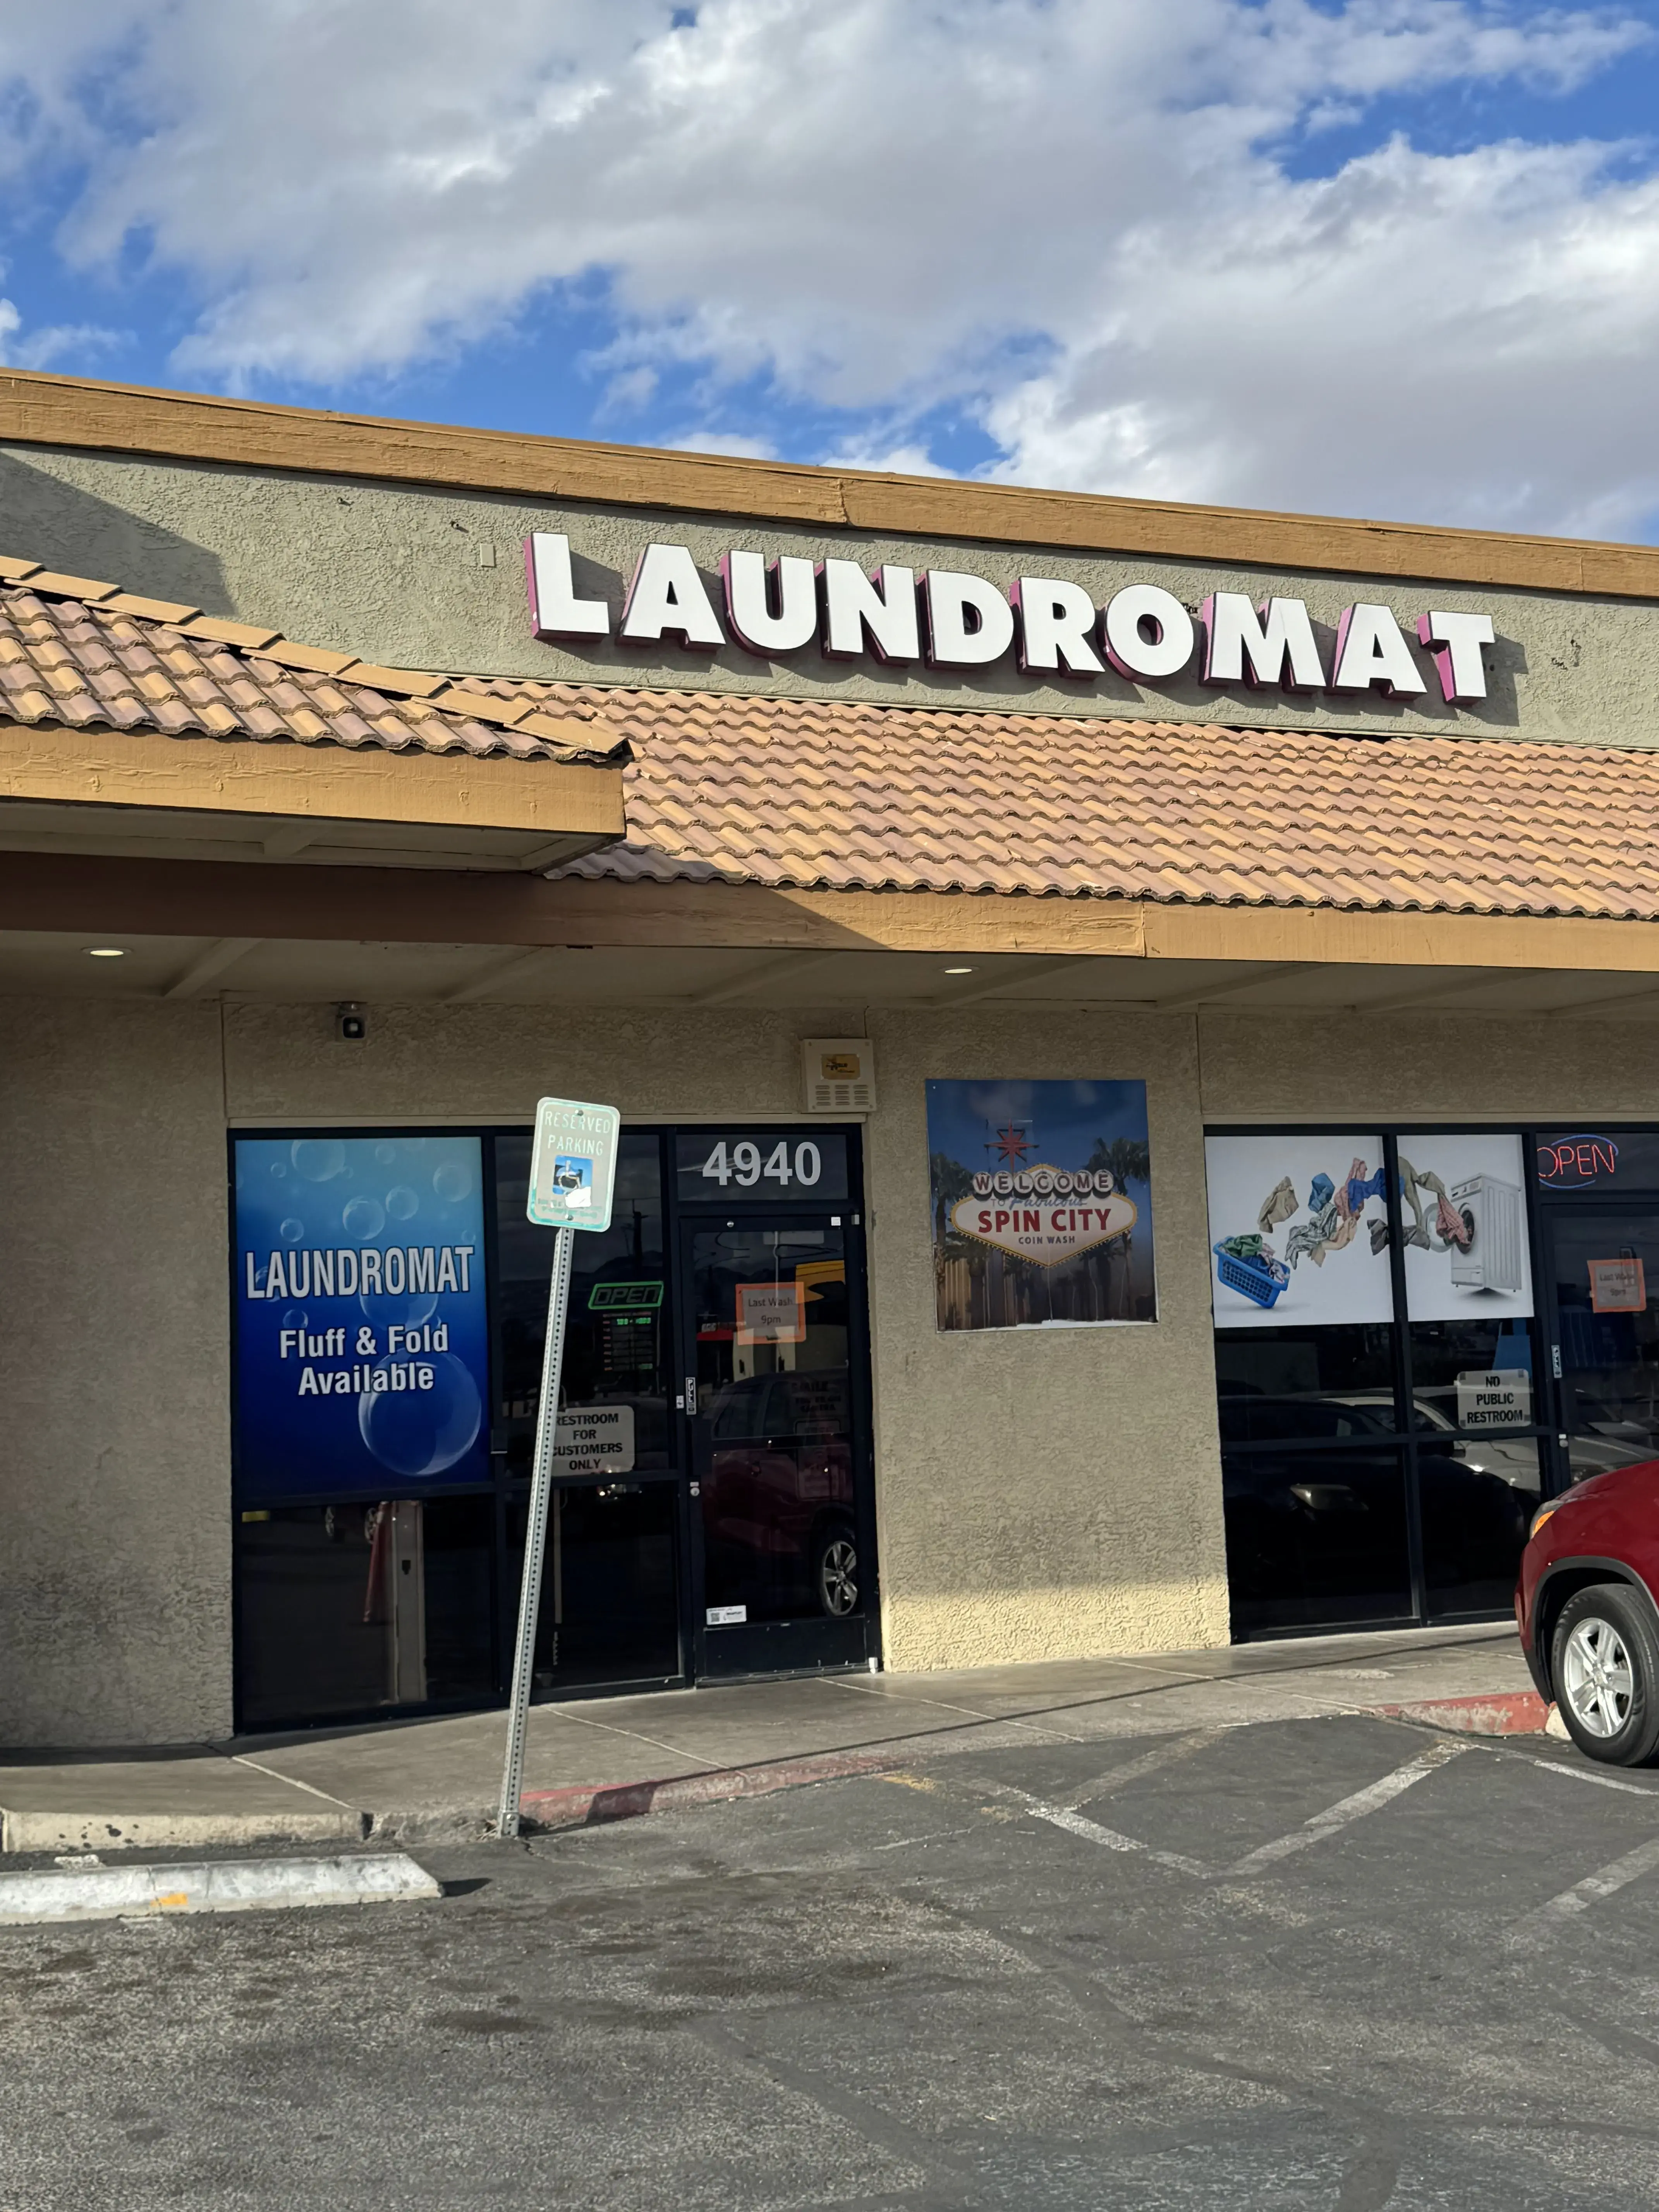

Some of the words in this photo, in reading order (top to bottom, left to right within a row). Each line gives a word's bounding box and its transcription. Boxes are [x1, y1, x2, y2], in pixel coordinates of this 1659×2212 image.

[527, 532, 1496, 700] LAUNDROMAT
[544, 1111, 611, 1134] RESERVED
[547, 1134, 604, 1156] PARKING
[702, 1141, 821, 1186] 4940
[1537, 1144, 1614, 1177] OPEN
[974, 1173, 1110, 1192] WELCOME
[990, 1199, 1006, 1207] TO
[978, 1209, 1041, 1233] SPIN
[1051, 1208, 1111, 1232] CITY
[1018, 1237, 1043, 1245] COIN
[1046, 1235, 1075, 1244] WASH
[246, 1245, 475, 1299] LAUNDROMAT
[594, 1286, 661, 1305] OPEN
[748, 1297, 766, 1307] Last
[768, 1297, 793, 1307] Wash
[761, 1315, 781, 1326] 9pm
[279, 1327, 346, 1358] Fluff
[356, 1326, 377, 1356] &
[388, 1324, 449, 1355] Fold
[298, 1362, 434, 1396] Available
[1486, 1376, 1501, 1387] NO
[1476, 1393, 1514, 1406] PUBLIC
[556, 1413, 619, 1425] RESTROOM
[1467, 1410, 1523, 1424] RESTROOM
[573, 1429, 597, 1440] FOR
[569, 1458, 601, 1470] ONLY
